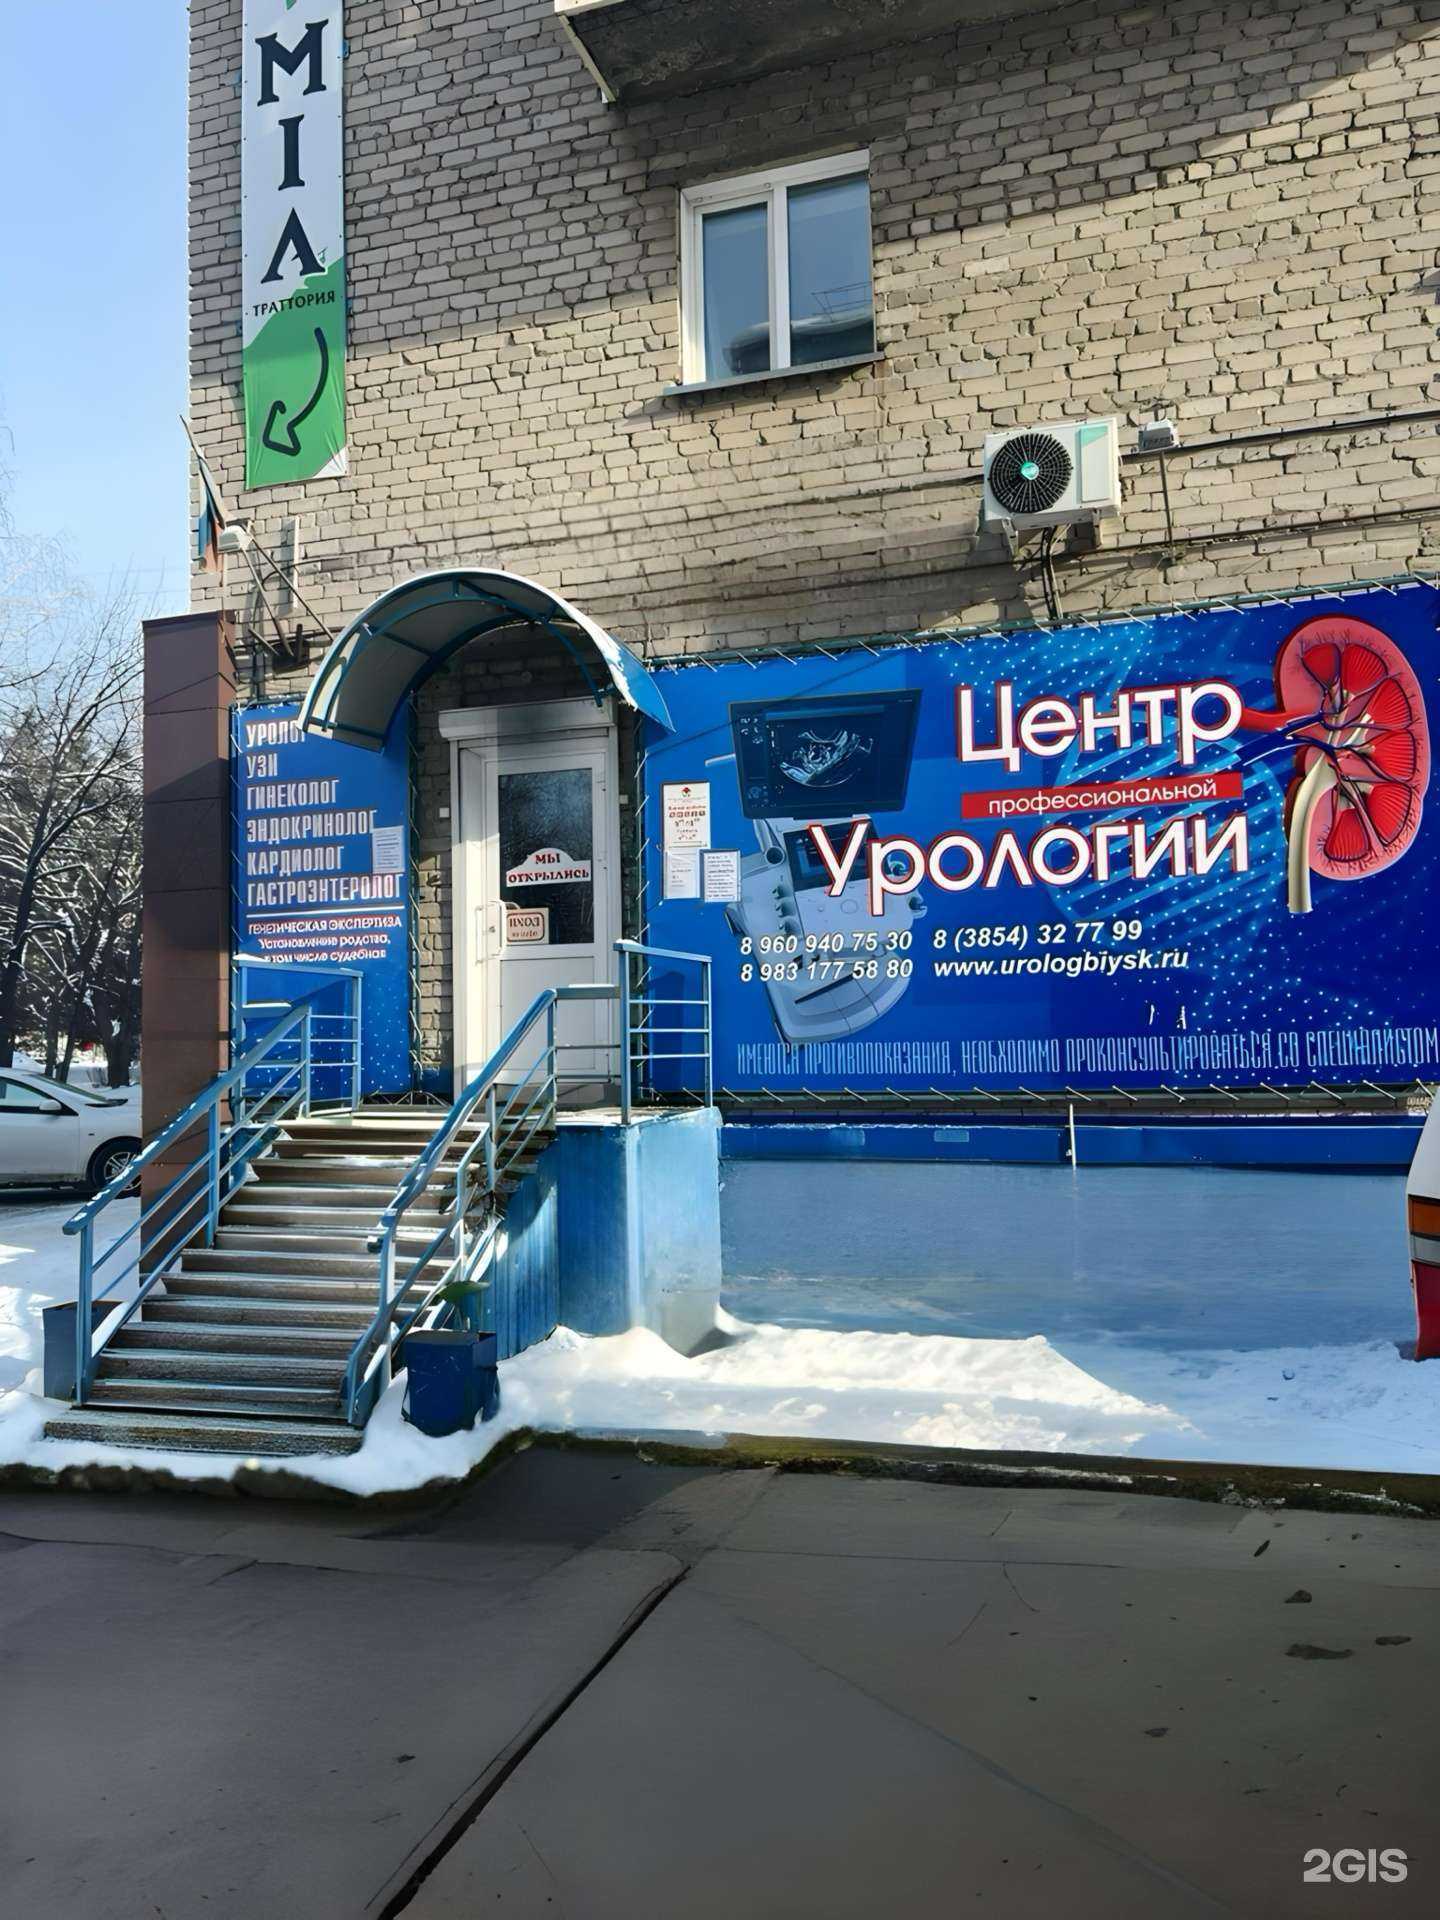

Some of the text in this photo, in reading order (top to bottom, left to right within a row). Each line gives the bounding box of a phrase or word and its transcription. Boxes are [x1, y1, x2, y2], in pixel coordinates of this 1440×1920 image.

[253, 290, 336, 316] ТРАТТОРИЯ
[956, 677, 1243, 772] Центр
[246, 752, 278, 778] УЗИ
[247, 780, 338, 809] ГИНЕКОЛОГ
[987, 778, 1217, 818] профессиональной
[247, 810, 377, 844] ЭНДОКРИНОЛОГ
[247, 846, 344, 877] КАРДИОЛОГ
[535, 853, 560, 864] МЫ
[807, 815, 1248, 917] Урологии
[247, 874, 403, 907] ГАСТРОЭНТЕРОЛОГ
[508, 869, 589, 883] ОТКРЫЛИСЬ
[740, 930, 913, 956] 8 960 940 75 30
[933, 919, 1143, 953] 8 (3854) 32 77 99
[740, 958, 913, 982] 8 983 177 58 80
[934, 949, 1190, 978] www.urologbiysk.ru
[737, 1041, 799, 1076] ИМЕЮТСЯ
[804, 1040, 957, 1077] ПРОТИВОПОКАЗАНИЯ,
[961, 1039, 1060, 1074] НЕОБХОДИМО
[1065, 1031, 1271, 1073] ПРОКОНСУЛЬТИРОВАТЬСЯ
[1278, 1031, 1300, 1067] СО
